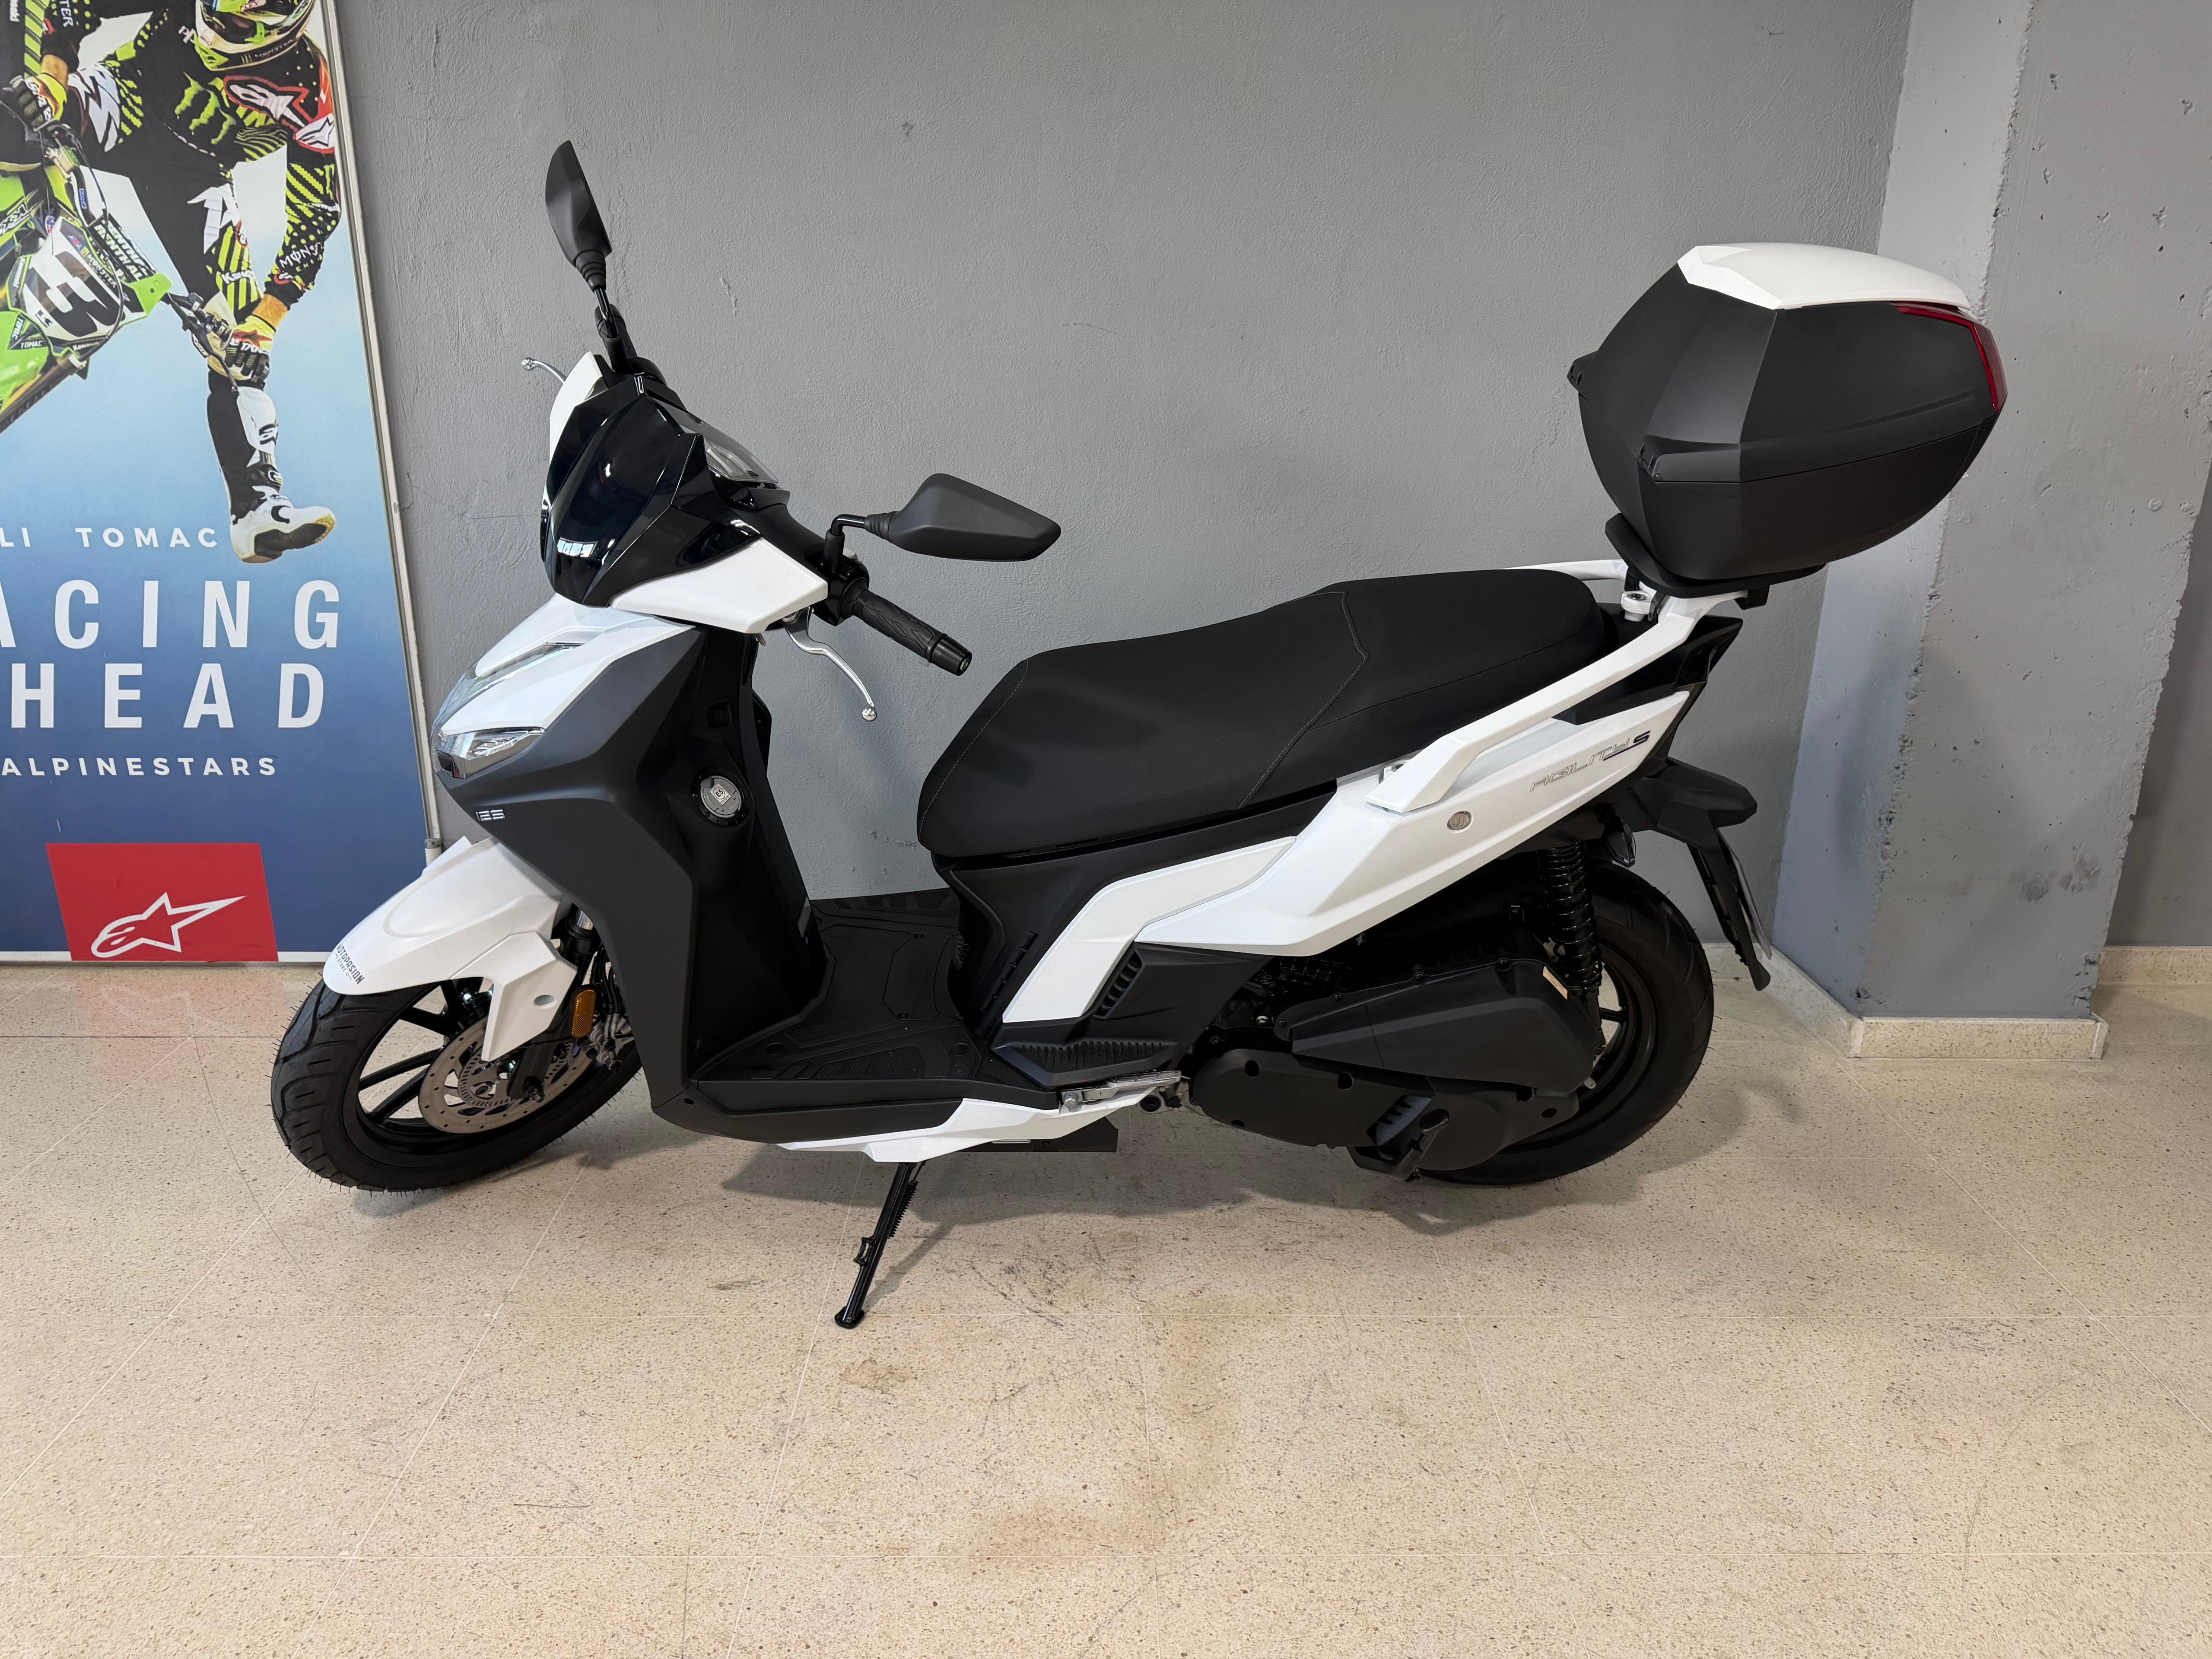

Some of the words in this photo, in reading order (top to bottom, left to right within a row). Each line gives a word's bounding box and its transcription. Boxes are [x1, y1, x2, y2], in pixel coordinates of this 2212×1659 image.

[20, 340, 43, 349] TOMAC
[75, 528, 217, 547] TOMAC
[11, 663, 324, 728] HEAD
[1, 757, 276, 776] ALPINESTARS
[1529, 737, 1630, 792] AGILITY
[715, 789, 724, 798] E5
[476, 809, 505, 821] 125
[336, 942, 365, 985] MOTOPASION
